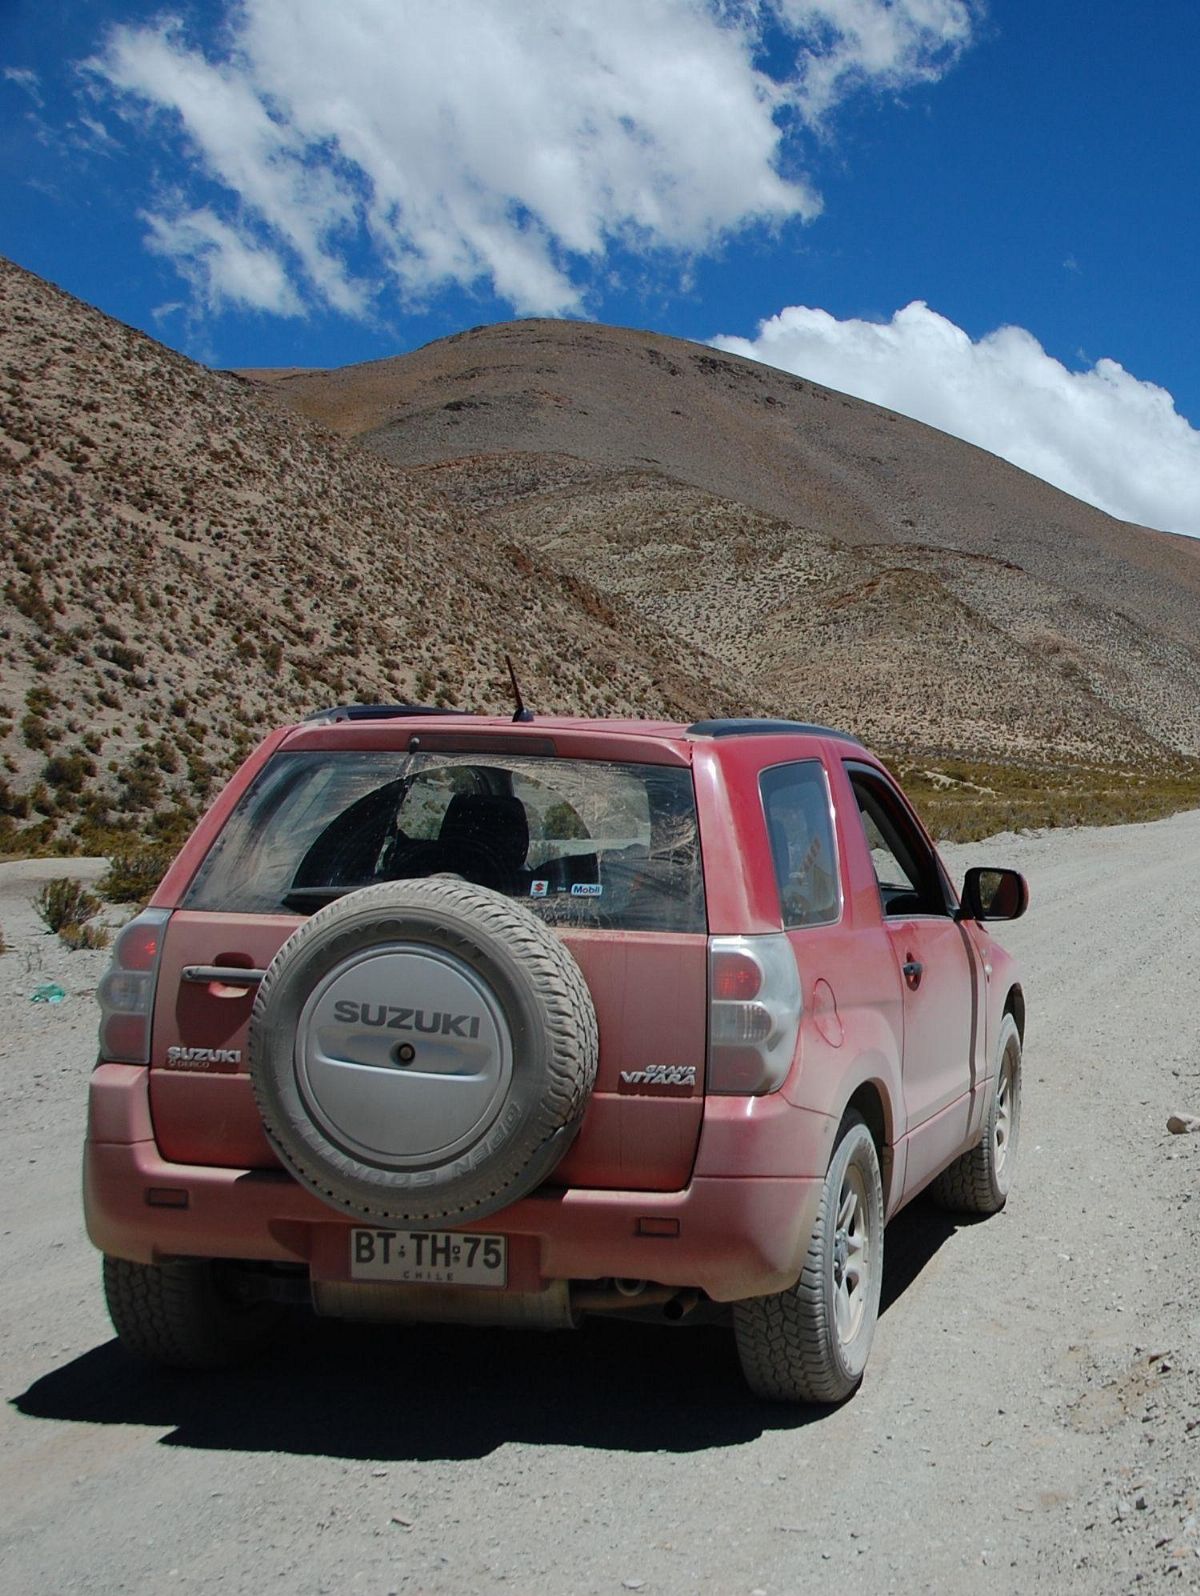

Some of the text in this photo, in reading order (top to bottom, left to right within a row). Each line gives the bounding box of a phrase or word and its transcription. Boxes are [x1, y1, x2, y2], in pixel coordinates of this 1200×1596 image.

[573, 885, 601, 894] Mobil
[334, 1000, 480, 1038] SUZUKI
[168, 1046, 241, 1063] SUZUKI
[645, 1064, 696, 1075] GRAND
[620, 1070, 696, 1086] VITARA
[403, 1271, 454, 1281] CHILE
